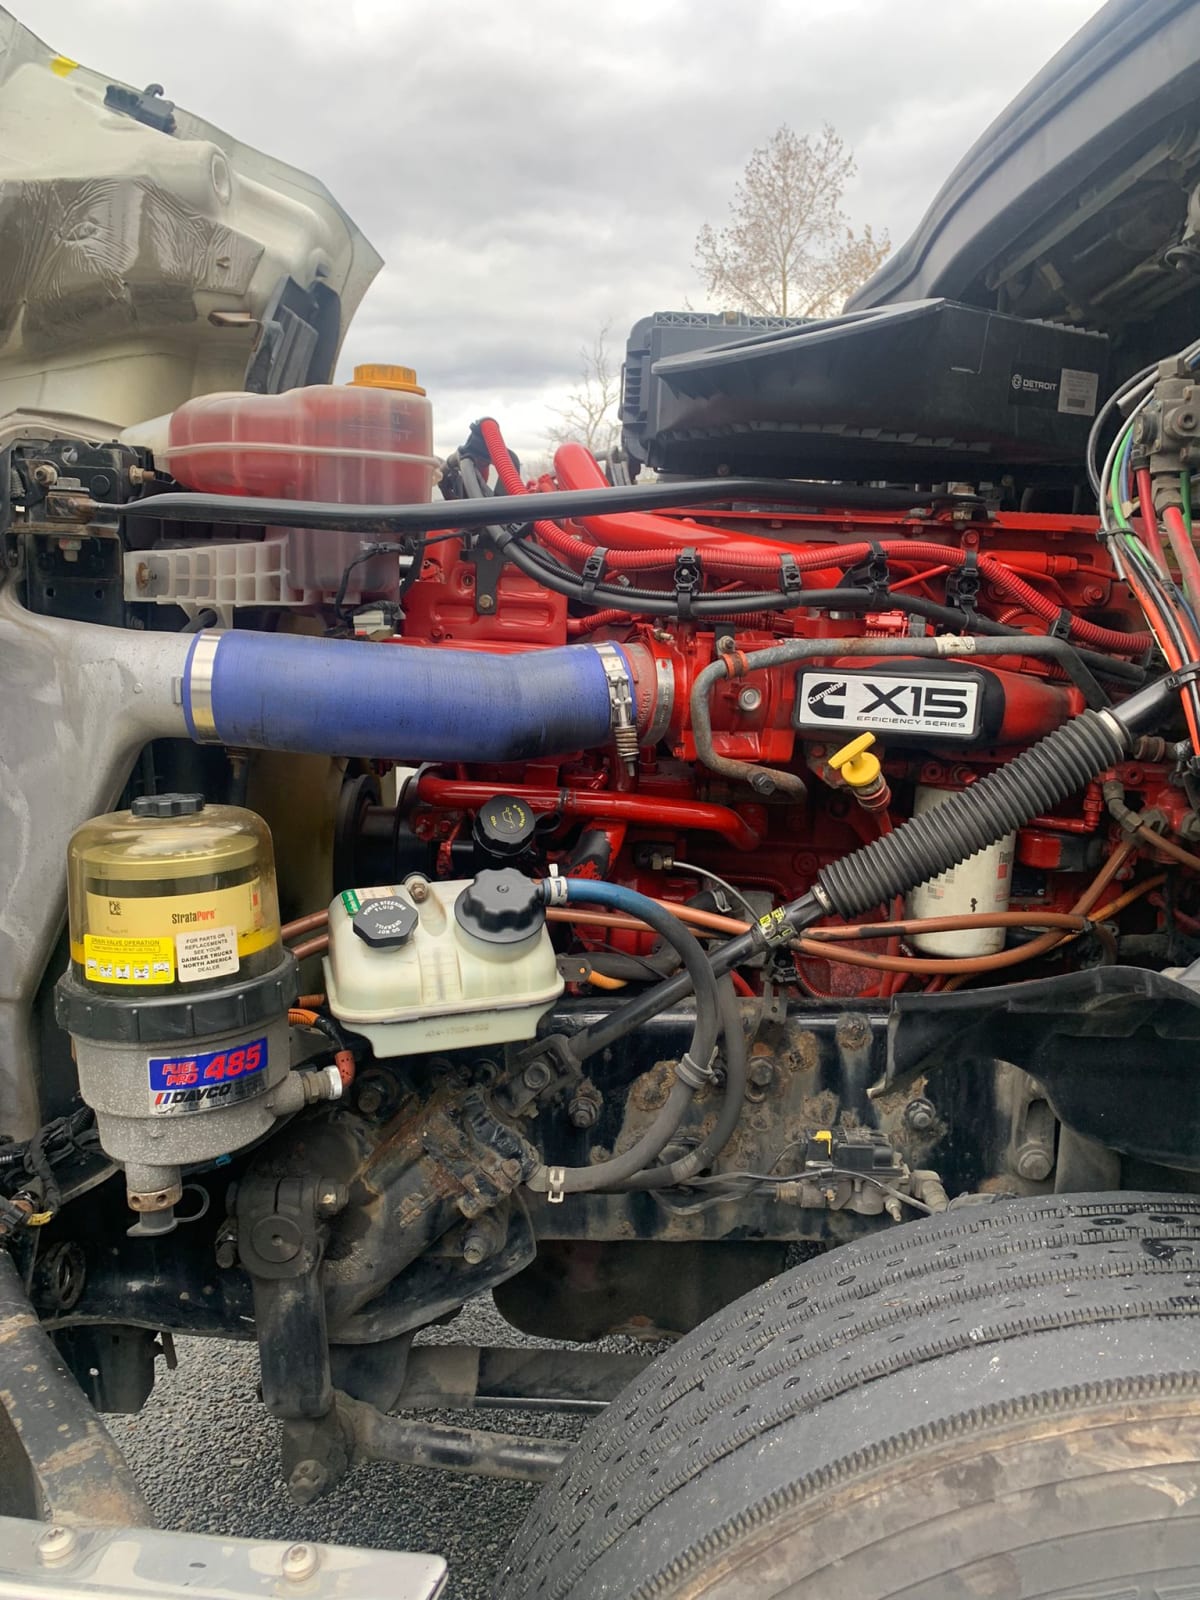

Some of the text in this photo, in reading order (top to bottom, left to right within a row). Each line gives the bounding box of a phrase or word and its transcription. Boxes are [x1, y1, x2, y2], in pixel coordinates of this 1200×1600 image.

[1023, 379, 1057, 391] DETROIT
[807, 682, 845, 705] Cummins
[859, 683, 967, 719] X15
[856, 715, 966, 728] EFFICIENCY SERIES
[363, 902, 379, 916] POWER
[380, 900, 407, 911] STEERING
[185, 939, 228, 950] REPLACEMENTS
[181, 949, 233, 963] DAIMLER TRUCKS
[183, 956, 232, 969] NORTH AMERICA
[197, 964, 220, 973] DEALER
[162, 1061, 199, 1075] FUEL
[204, 1043, 261, 1081] 485
[166, 1072, 198, 1087] PRO
[171, 1083, 232, 1104] DAVCO
